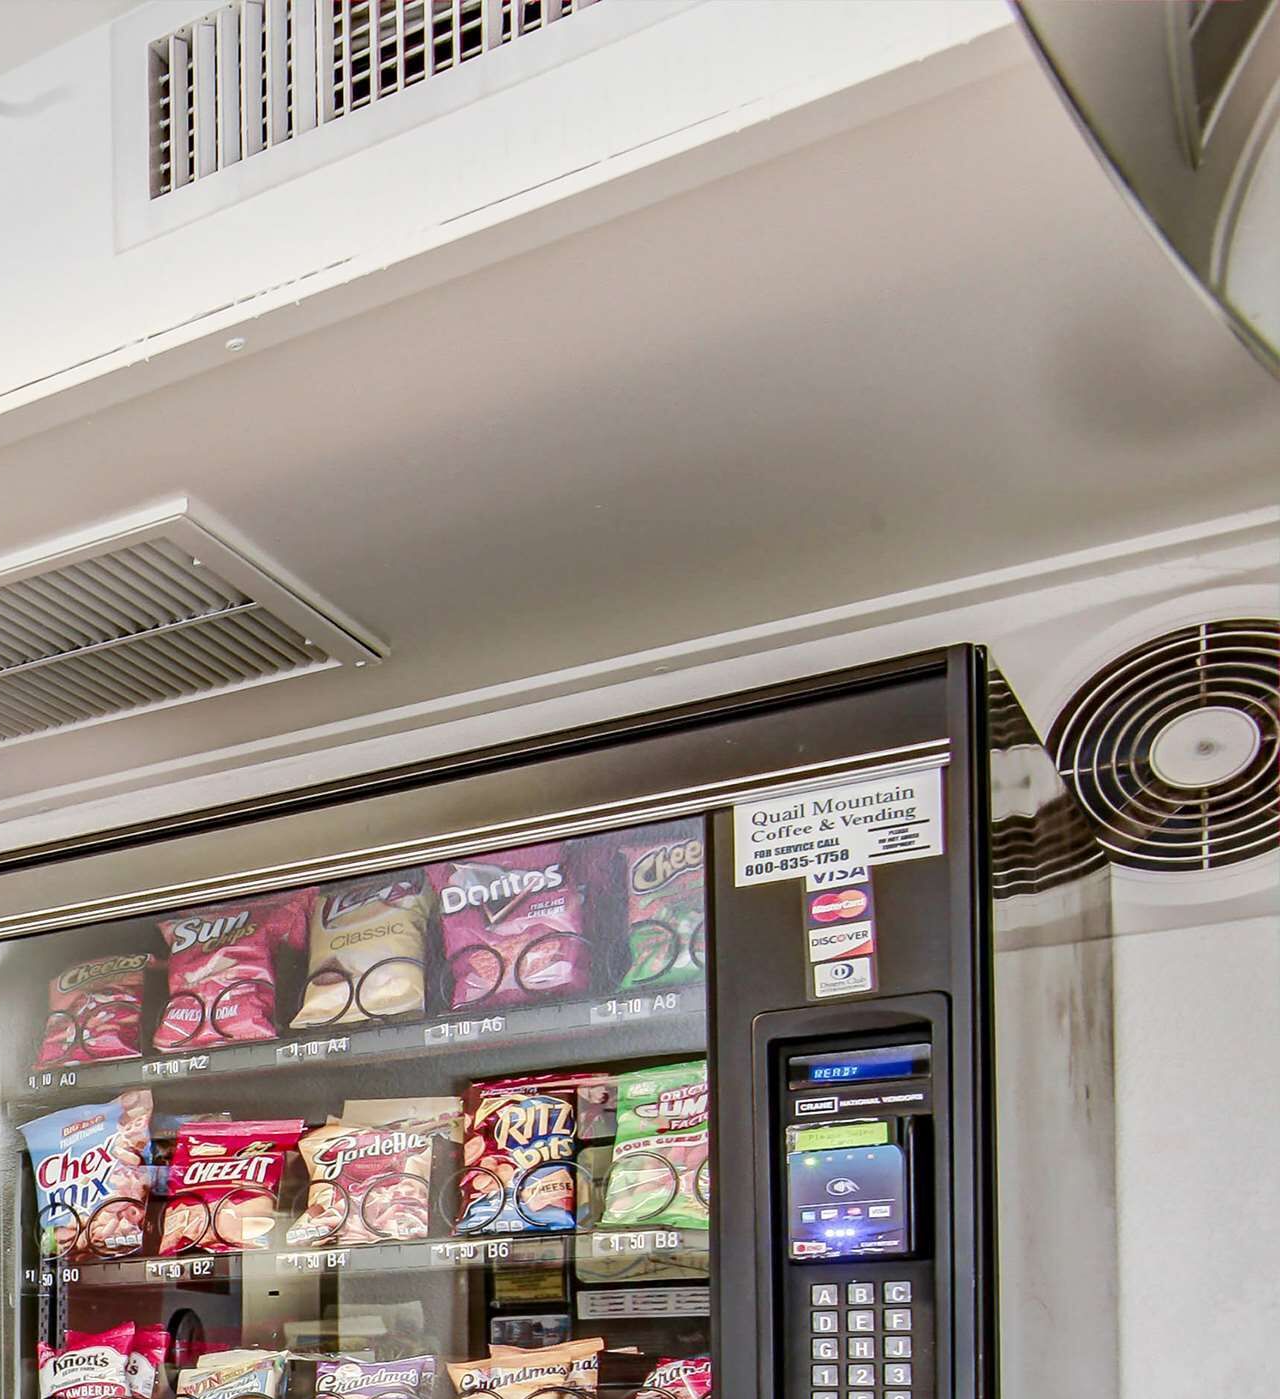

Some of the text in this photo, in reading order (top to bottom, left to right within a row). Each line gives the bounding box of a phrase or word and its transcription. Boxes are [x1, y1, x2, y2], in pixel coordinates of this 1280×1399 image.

[751, 785, 915, 826] Quail Mountain
[751, 805, 917, 843] Coffee & Vending
[754, 837, 840, 860] FOR SERVICE CALL
[633, 838, 704, 890] Chee
[744, 848, 850, 877] 800-835-1758
[441, 863, 564, 915] Doritos
[171, 911, 250, 954] Sun
[329, 921, 404, 951] Classic
[811, 930, 869, 947] DISCOVER
[60, 953, 149, 991] Cheetos
[653, 993, 677, 1010] A8
[481, 1018, 503, 1033] A6
[328, 1038, 347, 1053] A4
[189, 1055, 208, 1070] A2
[59, 1072, 76, 1087] A0
[814, 1065, 859, 1080] READY
[800, 1101, 833, 1111] CRANE
[500, 1102, 575, 1146] RITZ
[513, 1138, 575, 1169] bits
[615, 1140, 651, 1153] SOUR
[37, 1137, 116, 1188] Chex
[183, 1156, 274, 1185] CHEEZ-IT
[655, 1232, 679, 1248] B8
[488, 1243, 509, 1259] B6
[193, 1260, 211, 1275] B2
[327, 1253, 346, 1267] B4
[63, 1268, 79, 1282] B0
[818, 1287, 904, 1304] A B C
[820, 1314, 904, 1330] D E F
[820, 1342, 903, 1357] G H J
[52, 1352, 110, 1376] Knott's
[317, 1368, 419, 1393] Grandma's
[460, 1363, 568, 1391] Grandma's
[822, 1369, 904, 1383] 1 2 3
